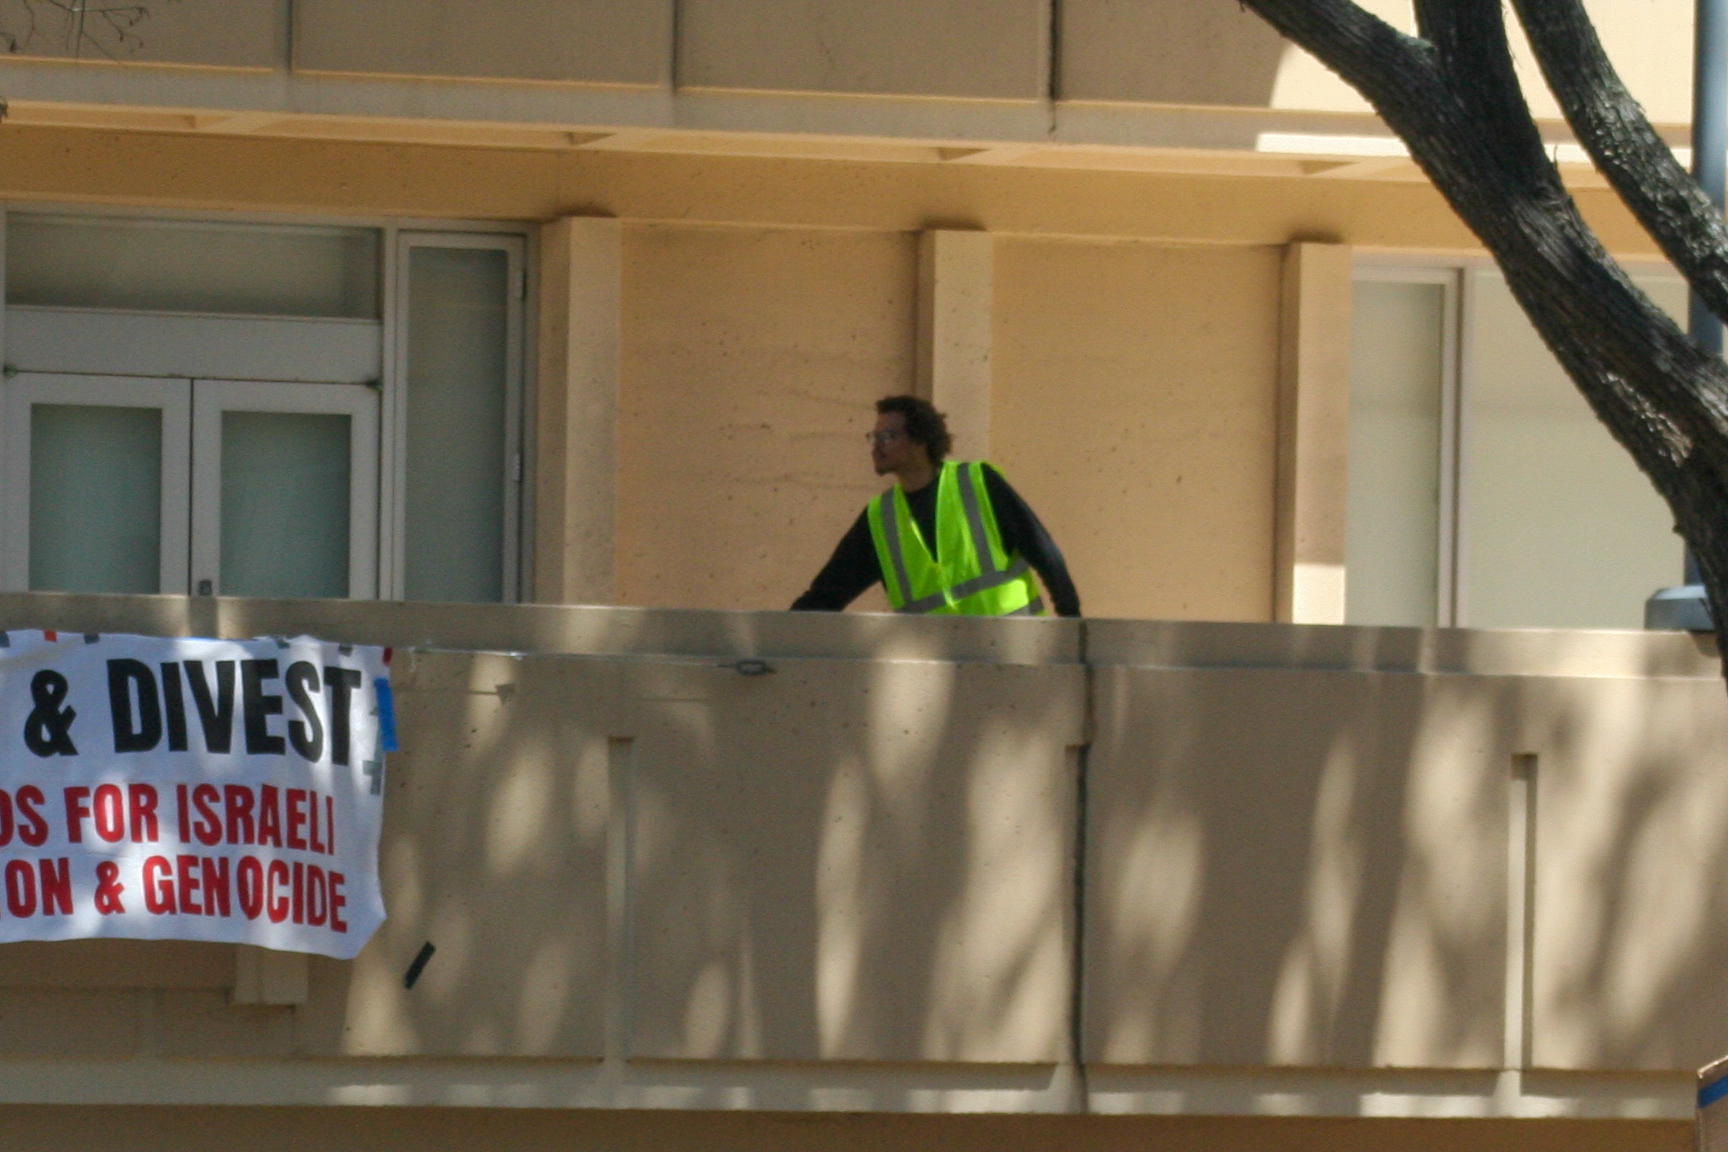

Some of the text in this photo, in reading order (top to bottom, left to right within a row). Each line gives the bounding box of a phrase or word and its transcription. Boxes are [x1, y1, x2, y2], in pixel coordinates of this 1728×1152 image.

[23, 668, 78, 758] &
[106, 656, 362, 767] DIVEST
[63, 782, 159, 845] FOR
[177, 783, 335, 854] ISRAELI
[94, 860, 126, 915] &
[142, 854, 348, 933] GENOCIDE
